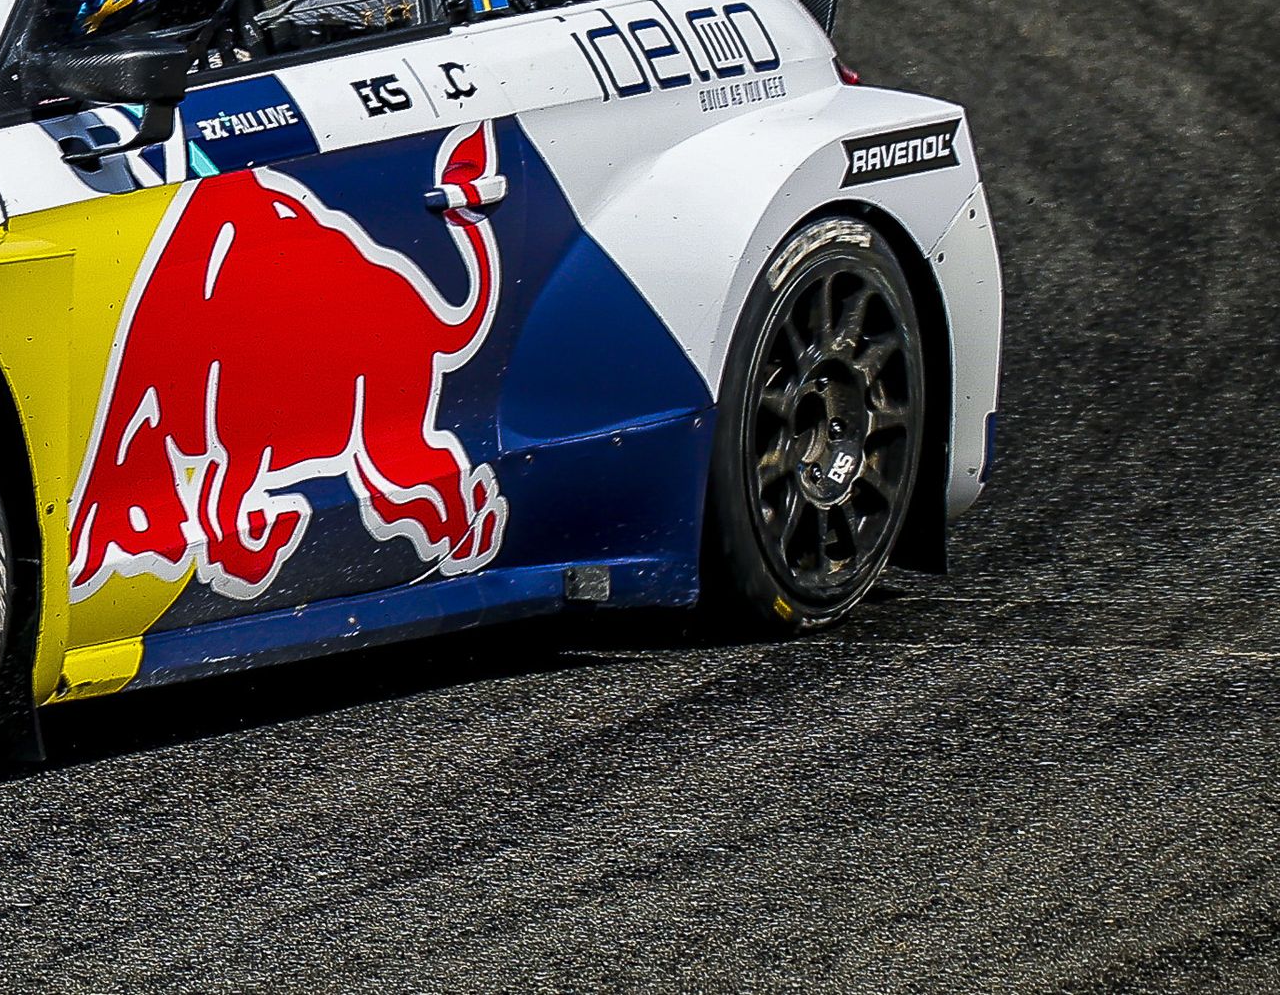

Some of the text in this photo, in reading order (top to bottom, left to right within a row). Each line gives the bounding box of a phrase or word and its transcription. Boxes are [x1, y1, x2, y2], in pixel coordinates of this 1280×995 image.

[350, 74, 413, 117] EKS
[261, 103, 299, 128] LIVE
[852, 133, 950, 174] RAVENOL
[827, 451, 854, 484] EKS
